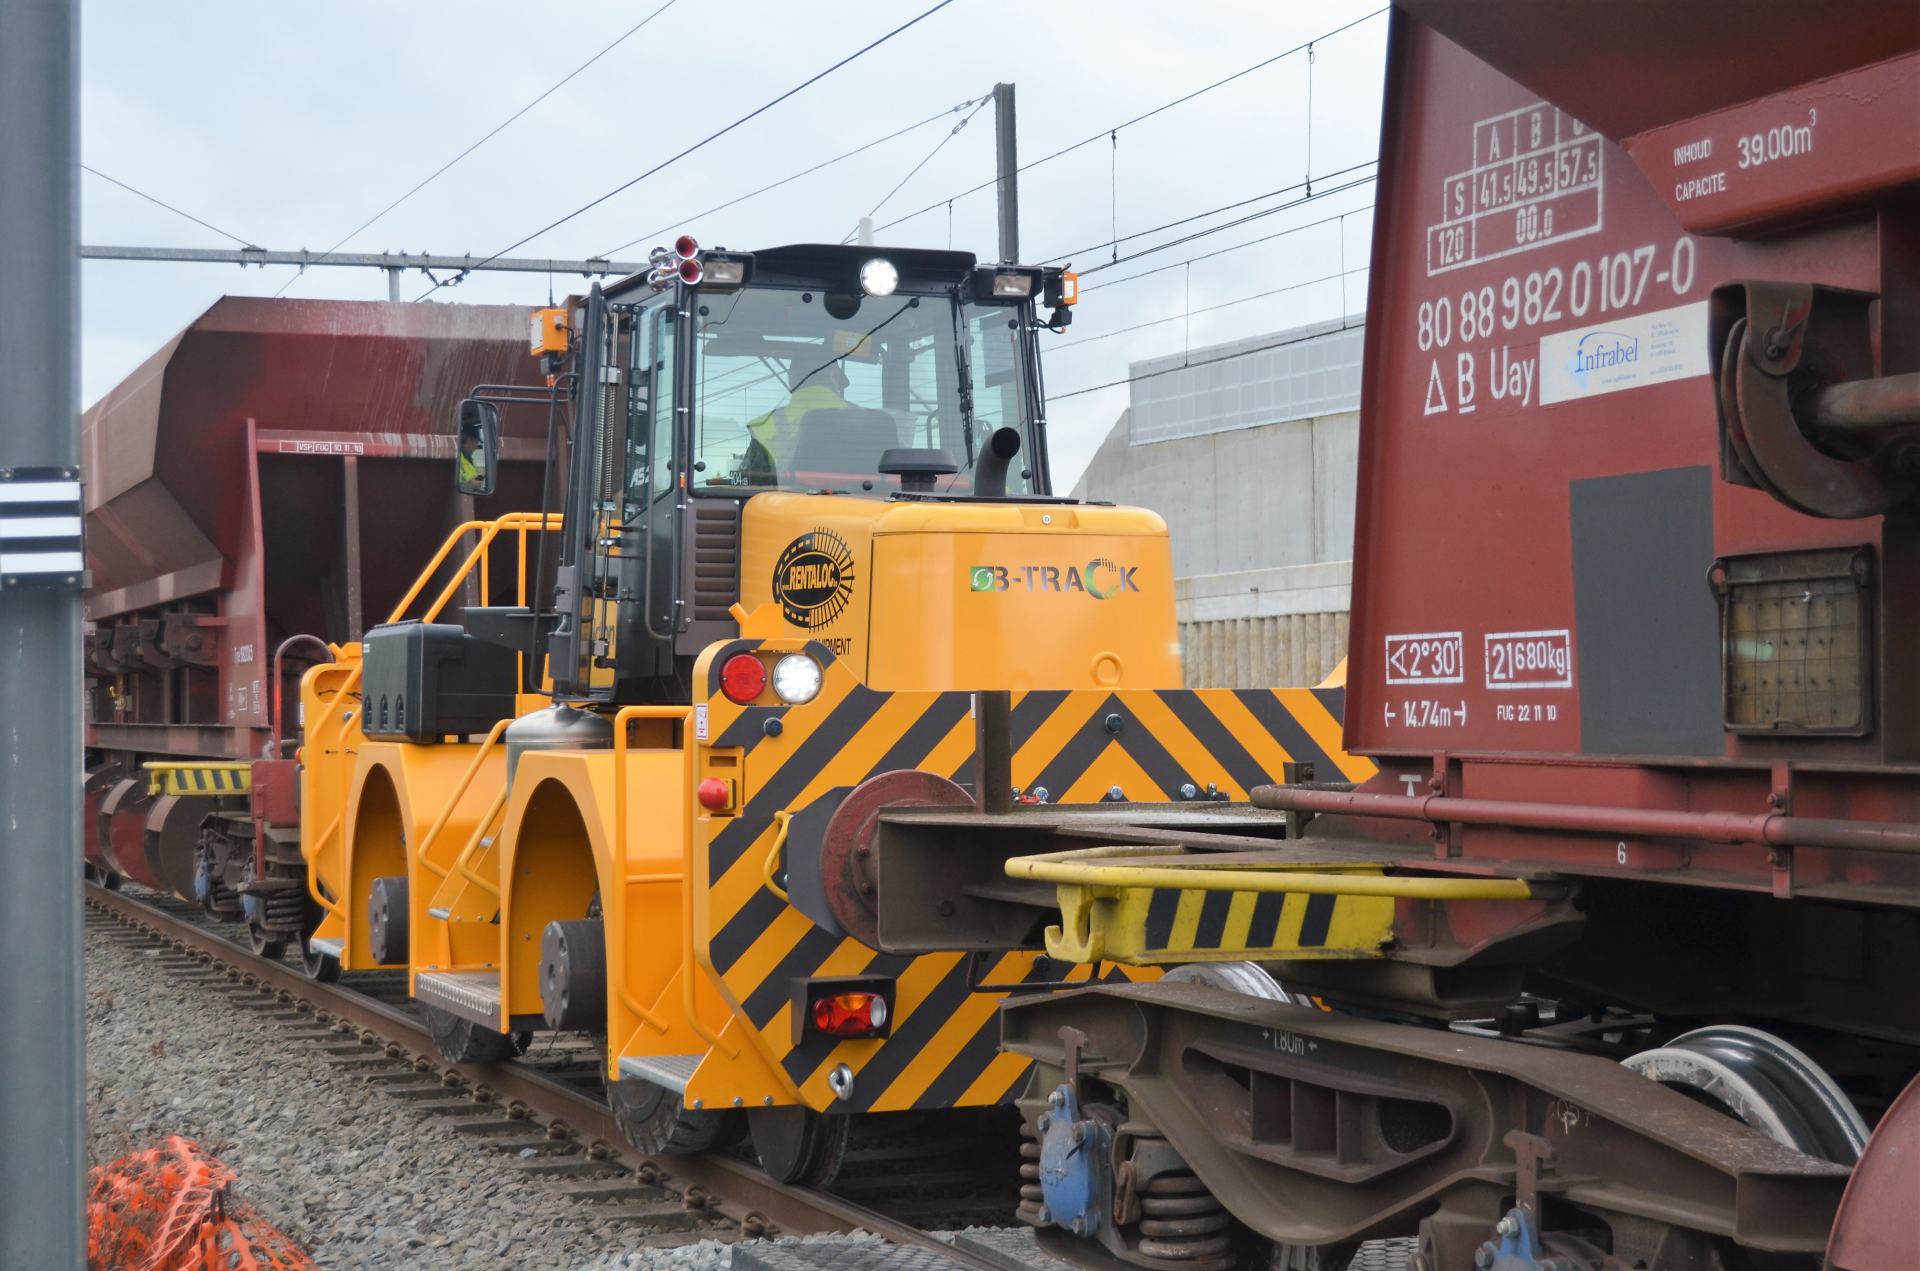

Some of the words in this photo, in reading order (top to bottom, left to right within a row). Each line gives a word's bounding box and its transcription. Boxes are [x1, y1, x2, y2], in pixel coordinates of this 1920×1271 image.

[1489, 125, 1501, 162] A
[1531, 112, 1541, 148] B
[1673, 138, 1712, 166] INHOUD
[1455, 181, 1464, 215] S
[1480, 171, 1511, 208] 41.5
[1517, 158, 1551, 196] 49.5
[1559, 147, 1596, 188] 57.5
[1675, 172, 1726, 201] CAPACITE
[1438, 226, 1464, 265] 120
[1516, 204, 1553, 244] 00.0
[1418, 297, 1451, 351] 80
[1459, 286, 1495, 343] 88
[1457, 351, 1475, 406] B
[1490, 345, 1535, 407] Uay
[995, 558, 1140, 600] B-TRACK
[1404, 700, 1450, 727] 14.74m
[1497, 704, 1514, 721] FUG
[1518, 704, 1530, 721] 22
[1534, 704, 1542, 721] 11
[1547, 704, 1557, 721] 10
[1617, 841, 1626, 864] 6
